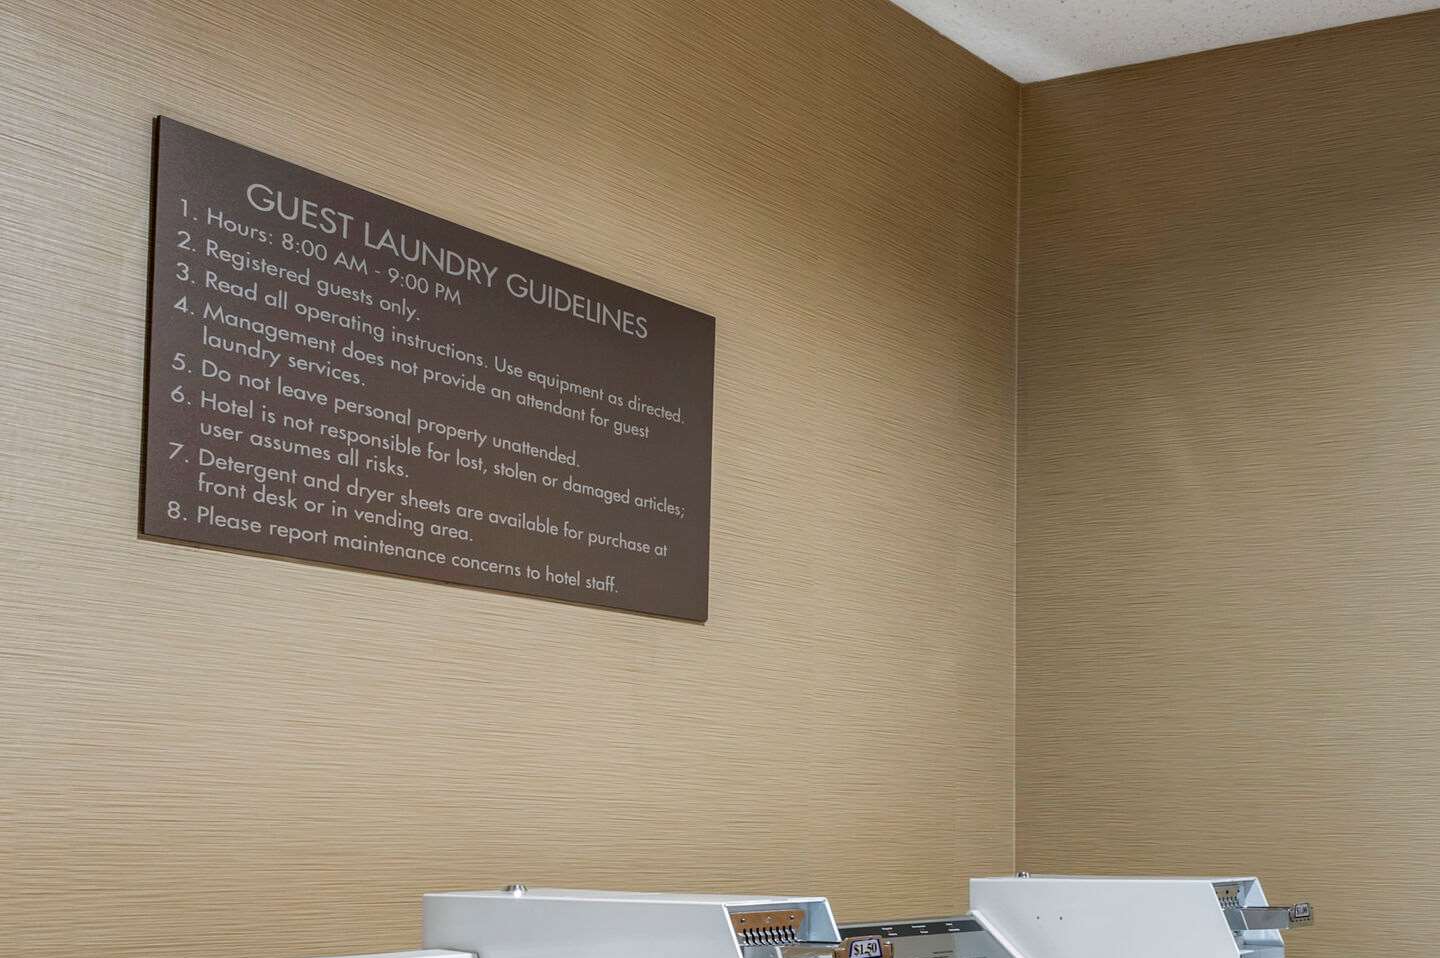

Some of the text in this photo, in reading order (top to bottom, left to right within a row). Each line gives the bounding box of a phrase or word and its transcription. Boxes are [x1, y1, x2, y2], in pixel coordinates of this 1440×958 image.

[176, 229, 420, 322] 2. Registered guests only.
[180, 197, 198, 221] 1.
[206, 206, 273, 245] Hours:
[281, 232, 328, 262] 8:00
[332, 250, 369, 276] AM
[387, 266, 429, 294] 9:00
[434, 281, 462, 306] PM
[246, 182, 648, 339] GUEST LAUNDRY GUIDELINES
[173, 295, 650, 440] 4. Management does not provide an attendant for guest
[175, 261, 685, 424] 3. Read all operating instructions. Use equipment as directed.
[202, 325, 365, 387] laundry services.
[170, 351, 580, 468] 5. Do not leave personal property unattended.
[170, 384, 685, 519] 6. Hotel is not responsible for lost, stolen or damaged articles;
[199, 421, 409, 478] user assumes all risks.
[166, 499, 619, 594] 8. Please report maintenance concerns to hotel staff.
[168, 440, 668, 557] 7. Detergent and dryer sheets are available for purchase at
[197, 471, 473, 542] front desk or in vending area.
[853, 942, 877, 956] $1.50
